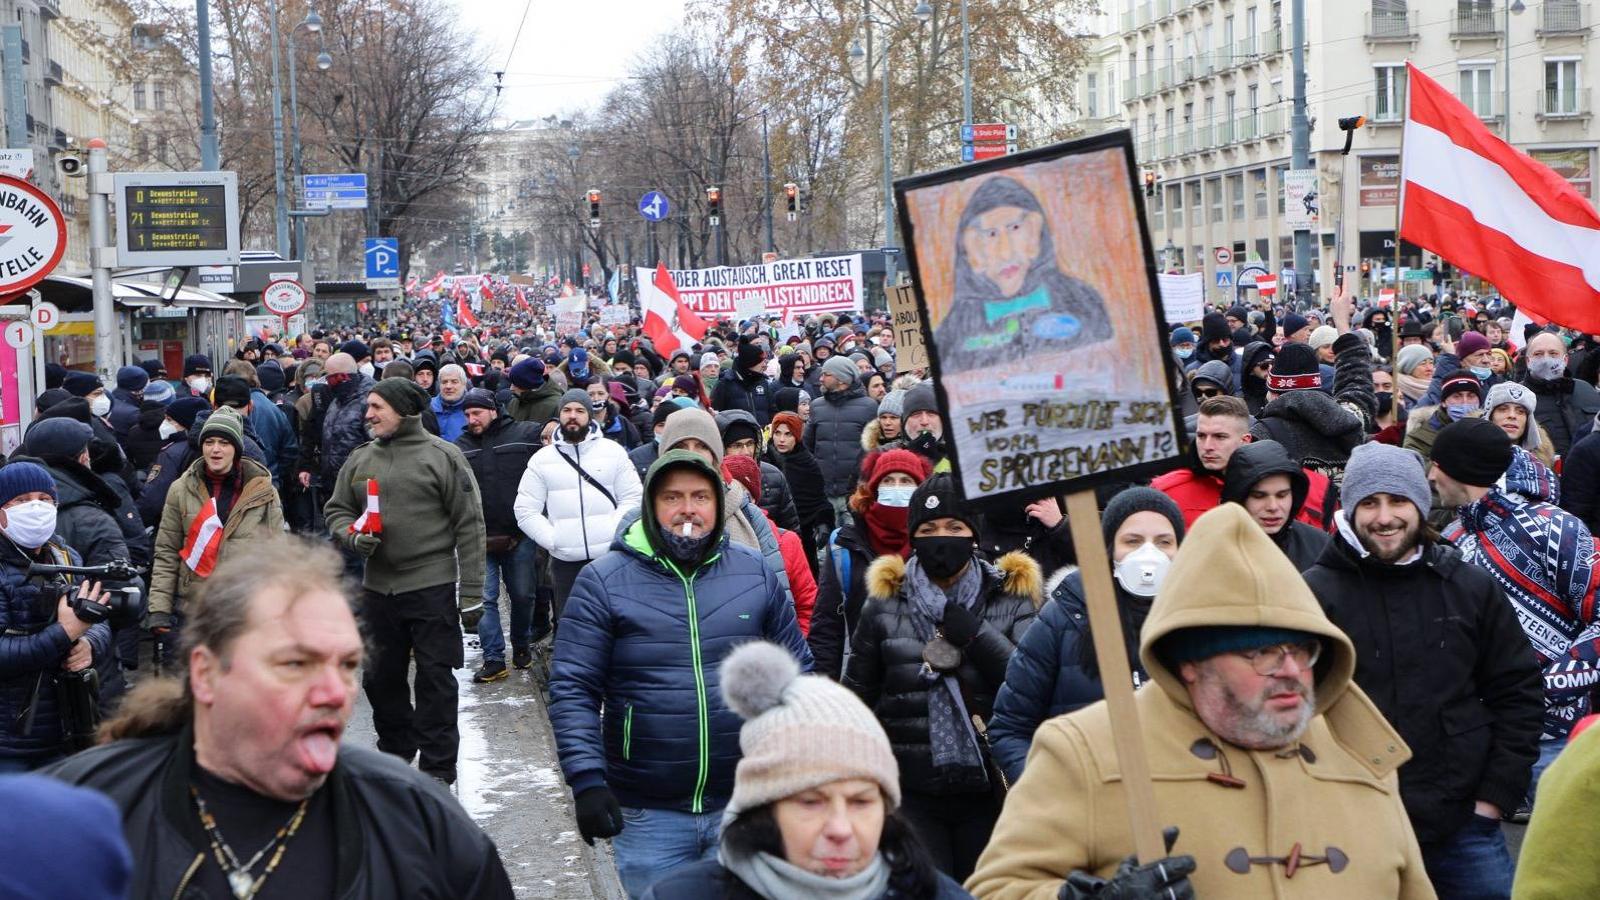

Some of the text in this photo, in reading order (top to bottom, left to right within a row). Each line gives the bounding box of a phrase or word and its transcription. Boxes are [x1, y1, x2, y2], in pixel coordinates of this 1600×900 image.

[150, 190, 198, 198] Demonstration
[131, 212, 143, 225] 71
[138, 233, 200, 246] 1 Demonstration
[704, 265, 770, 287] AUSTAUSCH,
[773, 262, 811, 281] GREAT
[816, 258, 852, 278] RESET
[708, 290, 731, 311] DEN
[38, 309, 51, 324] D
[16, 327, 23, 342] 1
[967, 408, 1008, 434] WER
[1123, 400, 1172, 426] SICH
[984, 432, 1040, 453] VORM
[978, 435, 1148, 492] SPRITZEMANN
[1487, 525, 1520, 561] EANS
[1544, 669, 1600, 689] TOMM
